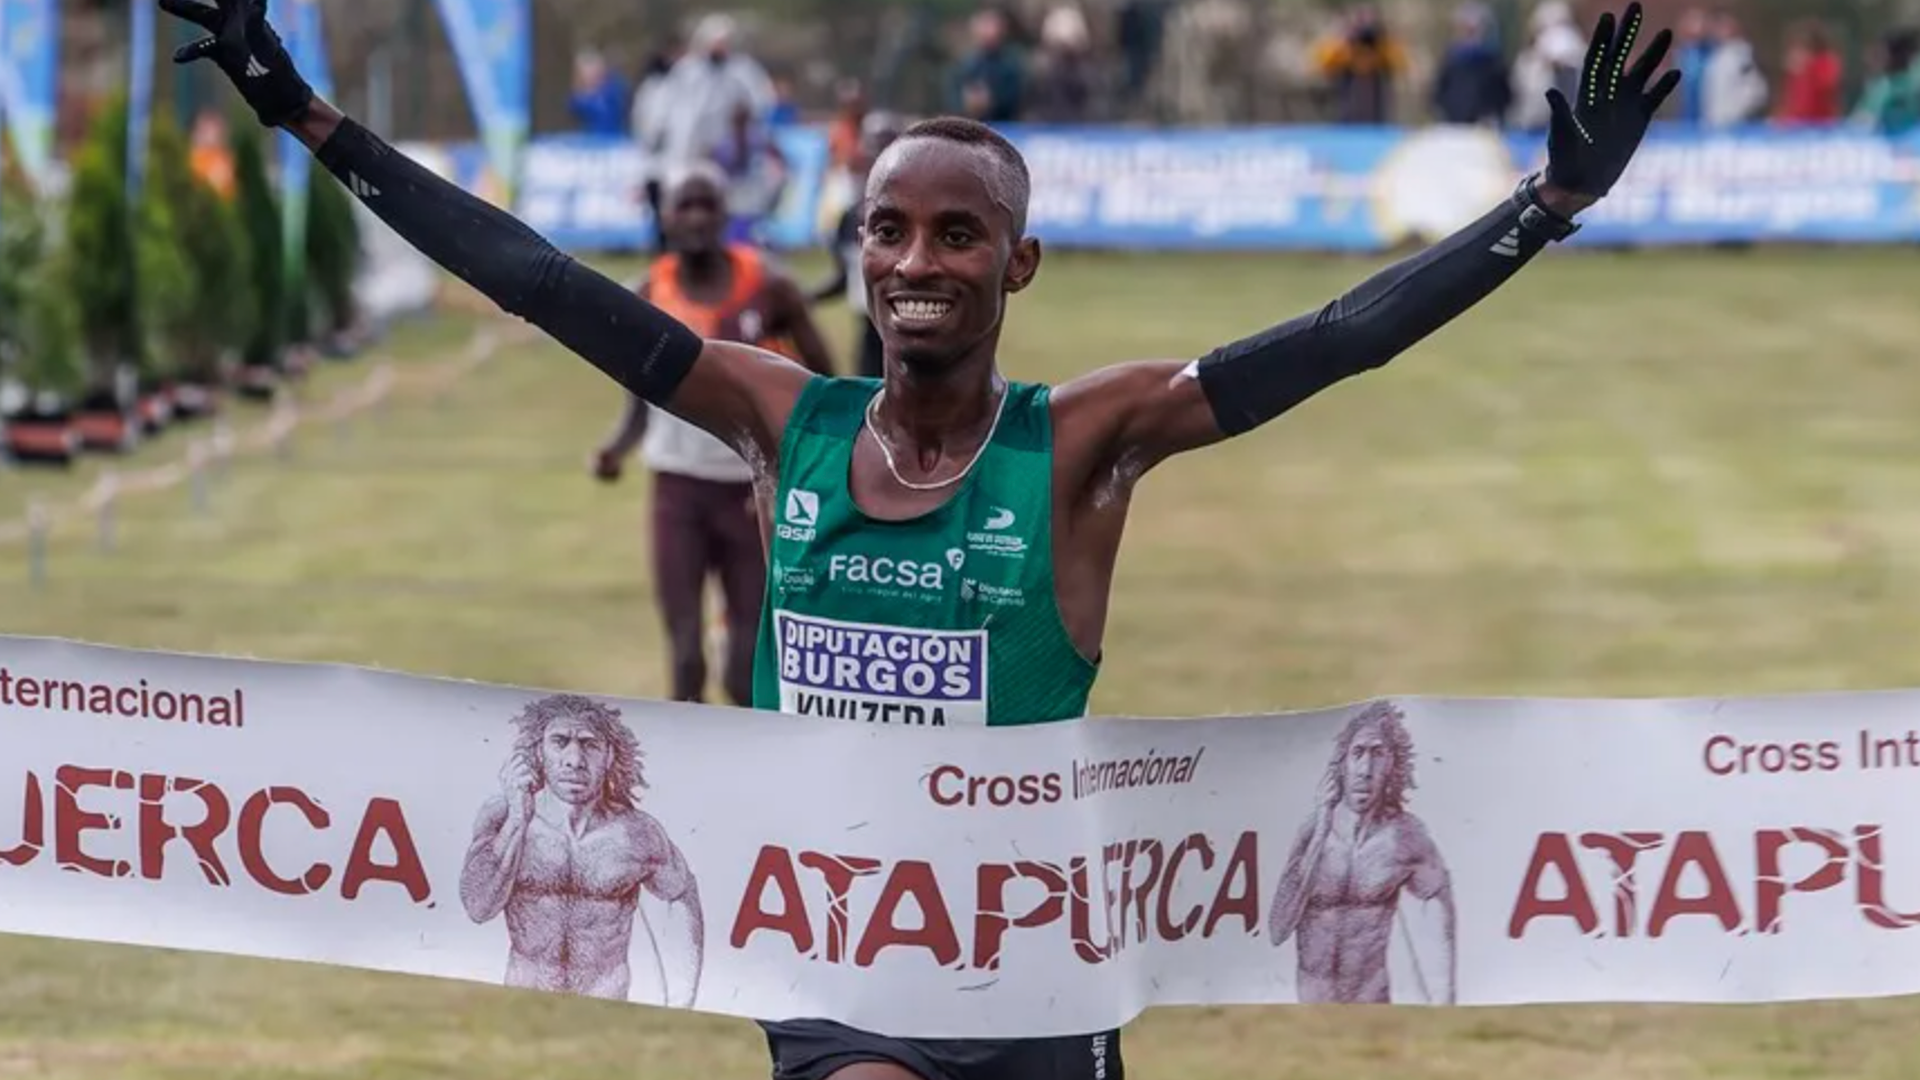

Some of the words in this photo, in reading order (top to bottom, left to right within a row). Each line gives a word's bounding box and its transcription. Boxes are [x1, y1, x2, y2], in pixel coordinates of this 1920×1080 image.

[786, 620, 970, 664] DIPUTACIÓN
[0, 668, 244, 728] ternacional
[783, 647, 971, 697] BURGOS
[929, 764, 1062, 806] Cross
[1073, 746, 1205, 800] Internacional
[1703, 734, 1841, 776] Cross
[1858, 729, 1920, 769] Int
[730, 830, 1260, 970] ATAPUERCA
